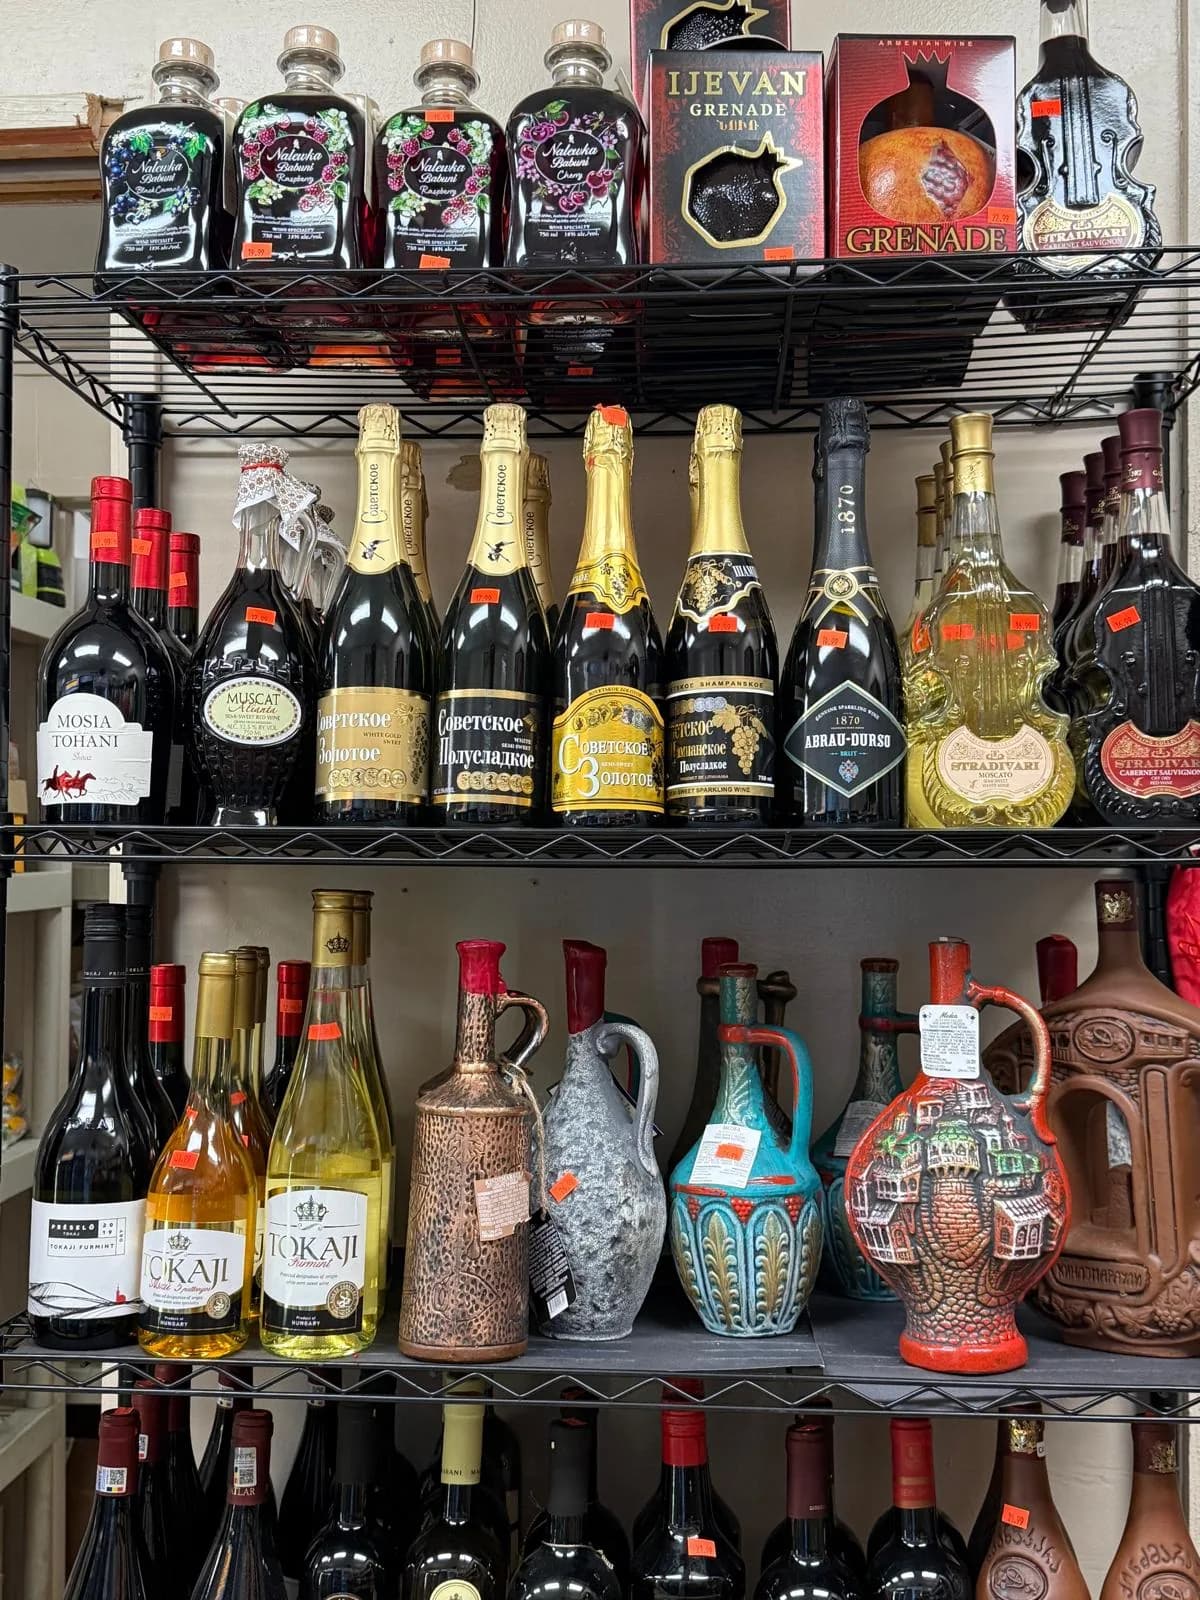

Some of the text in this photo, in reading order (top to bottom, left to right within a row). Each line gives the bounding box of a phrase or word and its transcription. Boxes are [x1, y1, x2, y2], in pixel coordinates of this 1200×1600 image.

[668, 71, 806, 95] IJEVAN
[690, 103, 786, 116] GRENADE
[267, 147, 323, 161] Nalewka
[542, 142, 598, 157] Nalewka
[132, 159, 183, 174] Nalewka
[275, 162, 314, 172] Babuni
[411, 158, 466, 173] Nalewka
[550, 157, 590, 168] Babuni
[140, 173, 176, 184] Babuni
[419, 174, 458, 184] Babuni
[556, 170, 583, 181] Cherry
[420, 186, 457, 196] Raspberry
[846, 227, 1008, 253] GRENADE
[1038, 227, 1128, 244] STRADIVARI
[1081, 238, 1124, 247] SAUVIGNON
[361, 463, 388, 524] Советское
[486, 464, 514, 525] Советское
[838, 484, 856, 534] 1870
[700, 680, 764, 689] SHAMPANSKOE
[227, 693, 280, 706] MUSCAT
[836, 716, 860, 725] 1870
[868, 707, 880, 720] WINE
[58, 715, 112, 729] MOSIA
[317, 710, 392, 736] Советское
[438, 709, 524, 736] Советское
[52, 735, 119, 748] TOHANI
[805, 733, 891, 749] ABRAU-DURSO
[320, 737, 381, 765] Золотое
[440, 737, 535, 770] Полусладкое
[680, 760, 727, 774] Полусладкое
[951, 762, 1040, 771] STRADIVARI
[269, 1232, 358, 1267] TOKAJI
[288, 1256, 333, 1269] Furmint
[144, 1252, 229, 1290] TOKAJI
